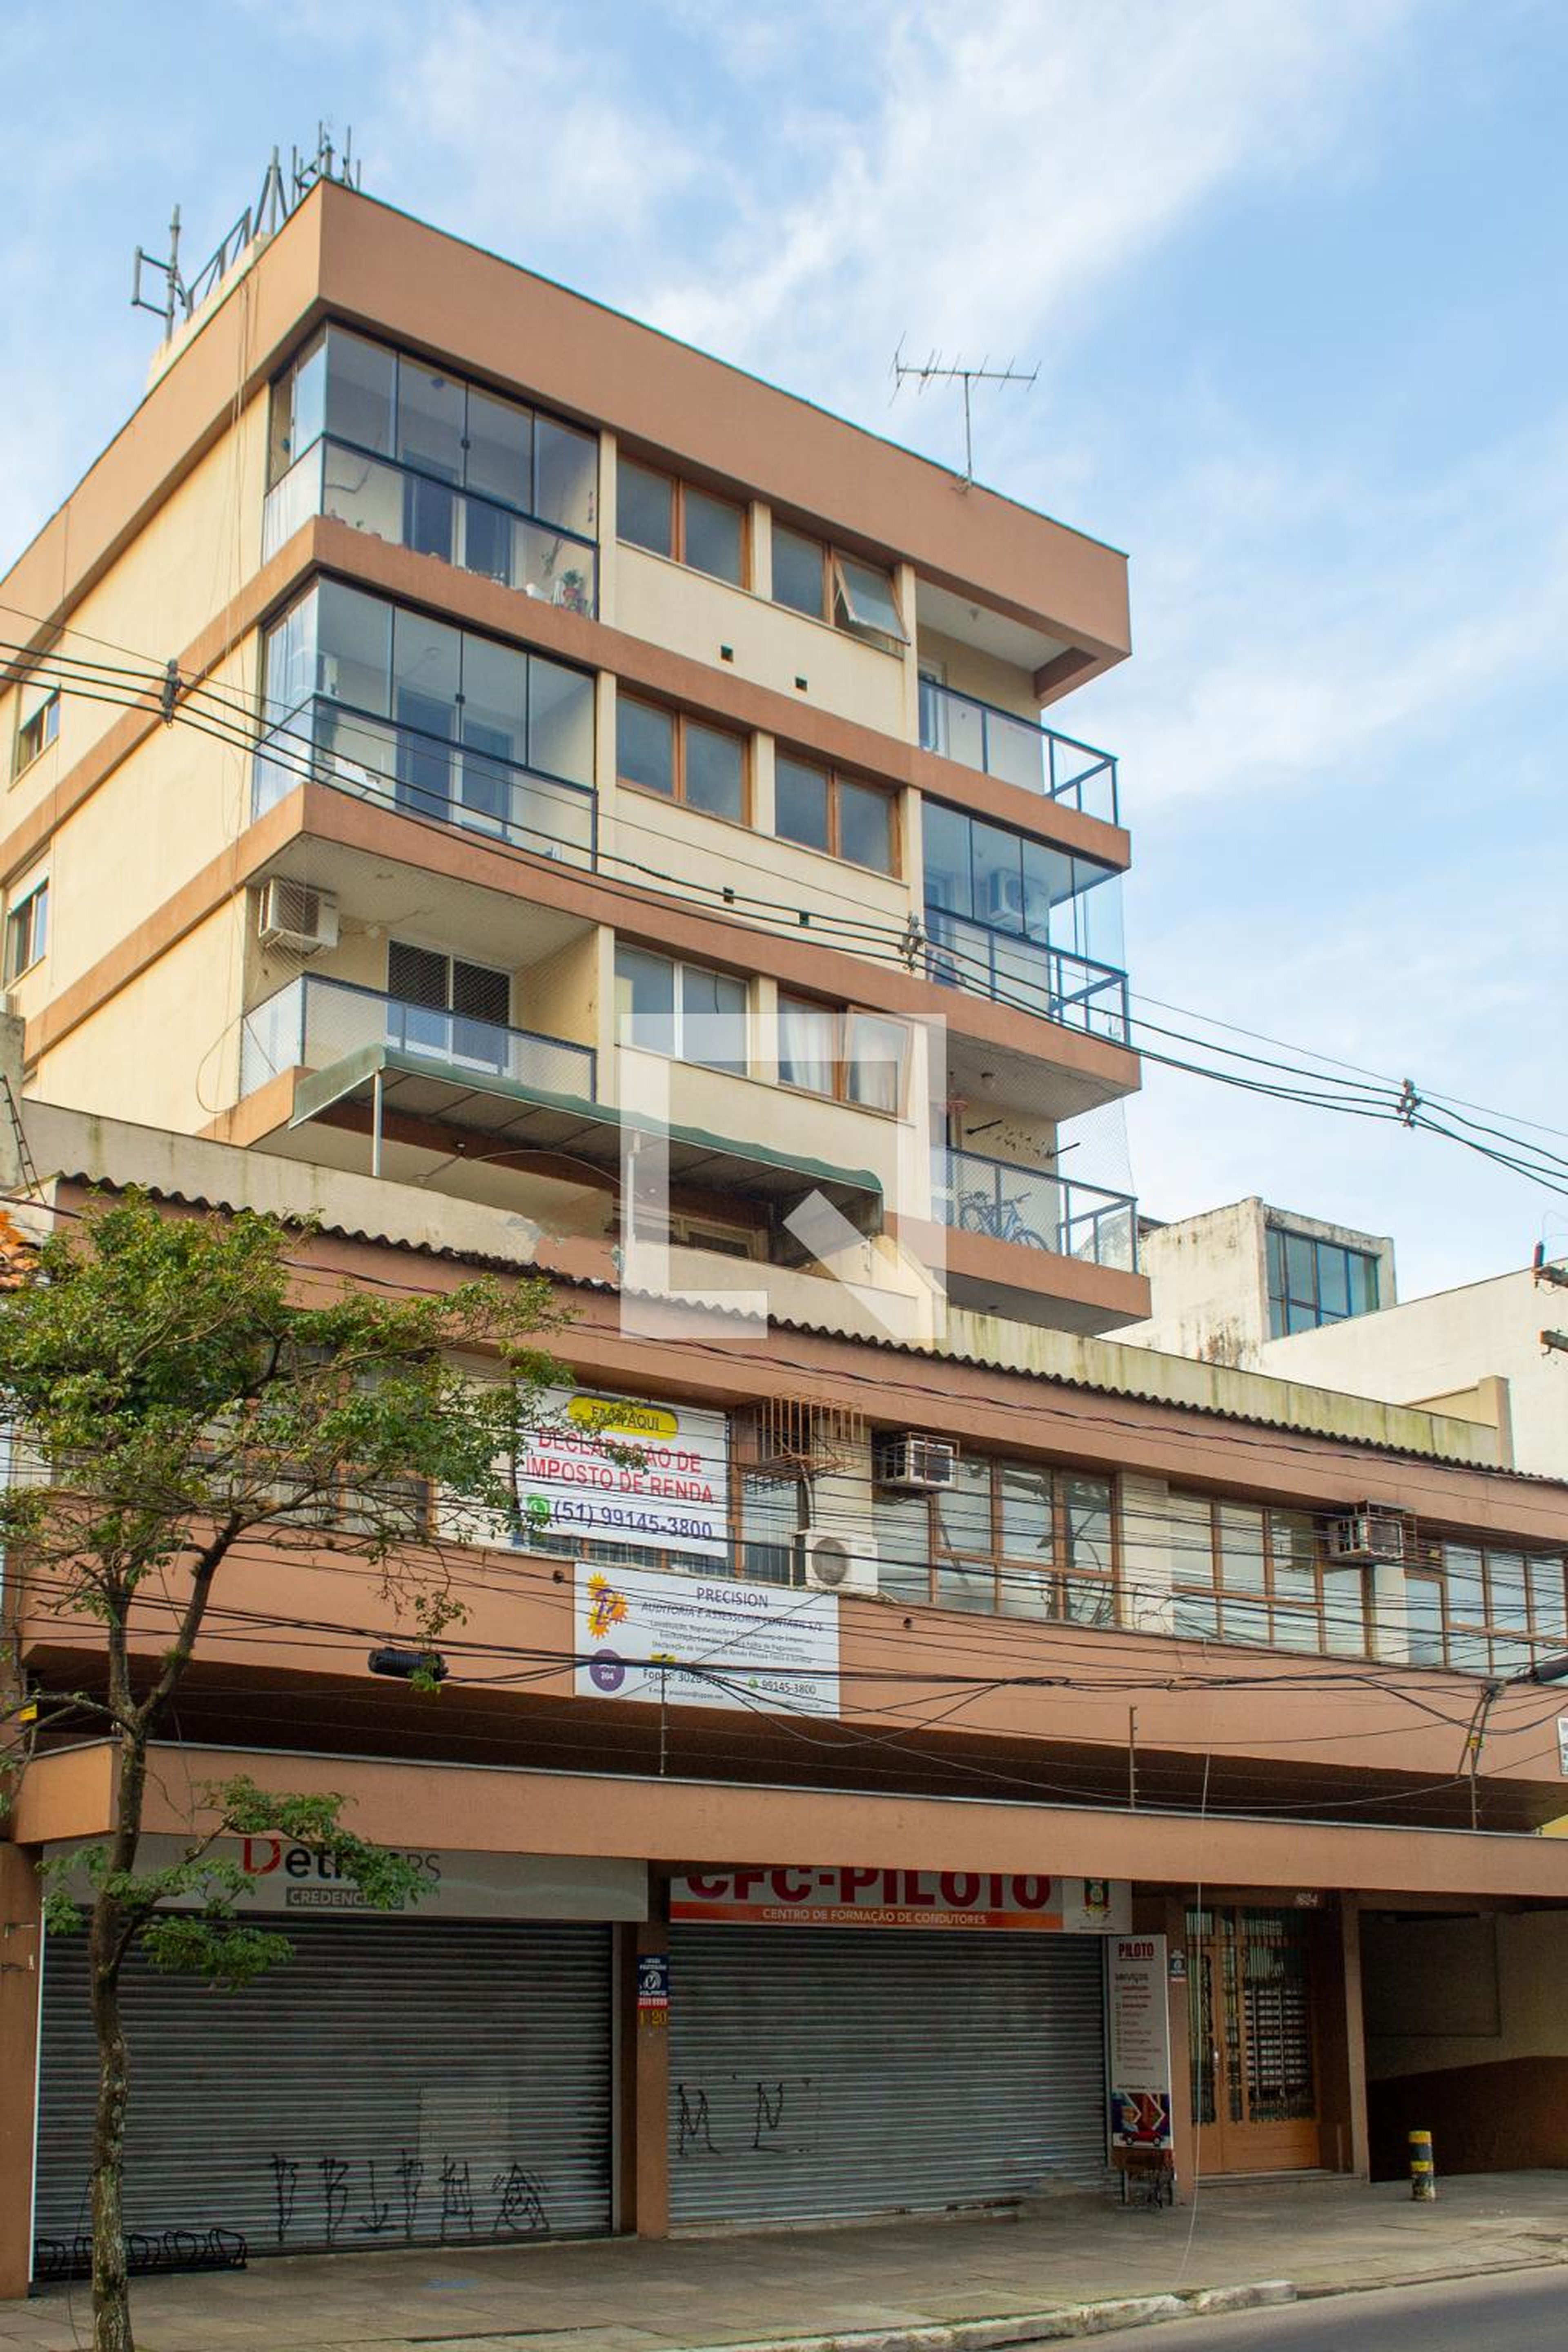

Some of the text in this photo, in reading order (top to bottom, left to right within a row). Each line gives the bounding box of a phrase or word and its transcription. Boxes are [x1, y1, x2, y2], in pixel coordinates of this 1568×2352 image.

[677, 1450, 702, 1473] DE
[526, 1454, 713, 1504] IMPOSTO DE RENDA
[555, 1500, 712, 1539] (51) 99145-3800
[697, 1586, 768, 1608] PRECISION
[762, 1908, 987, 1924] CENTRO DE FORMAÇÃO DE CONDUTORES
[1118, 1942, 1154, 1958] PILOTO
